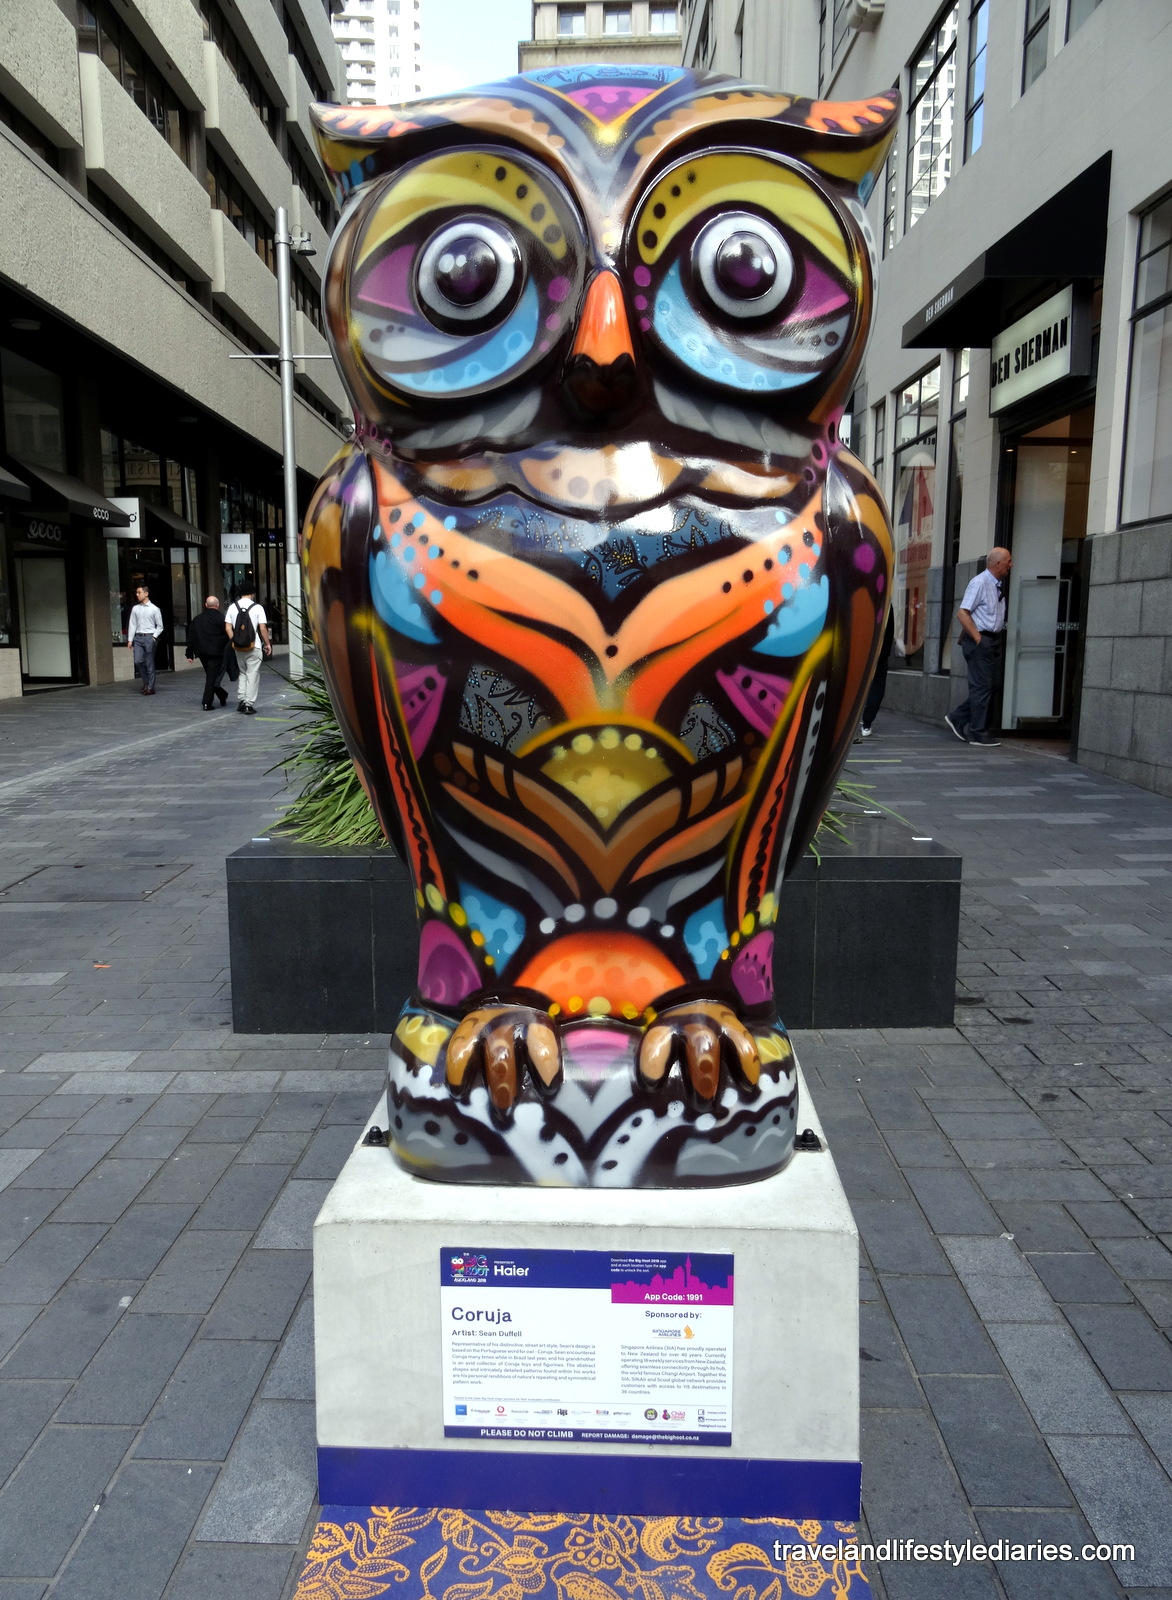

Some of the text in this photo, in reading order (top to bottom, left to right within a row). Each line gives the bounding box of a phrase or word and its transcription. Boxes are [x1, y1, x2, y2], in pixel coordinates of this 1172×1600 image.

[926, 286, 954, 322] BEN SHERMAN
[991, 316, 1068, 388] BEN SHERMAN
[93, 507, 109, 521] ecco
[29, 520, 62, 542] ecco
[494, 1265, 529, 1276] Haier
[644, 1293, 660, 1301] App
[451, 1307, 512, 1324] Coruja
[645, 1310, 688, 1318] Sponsored
